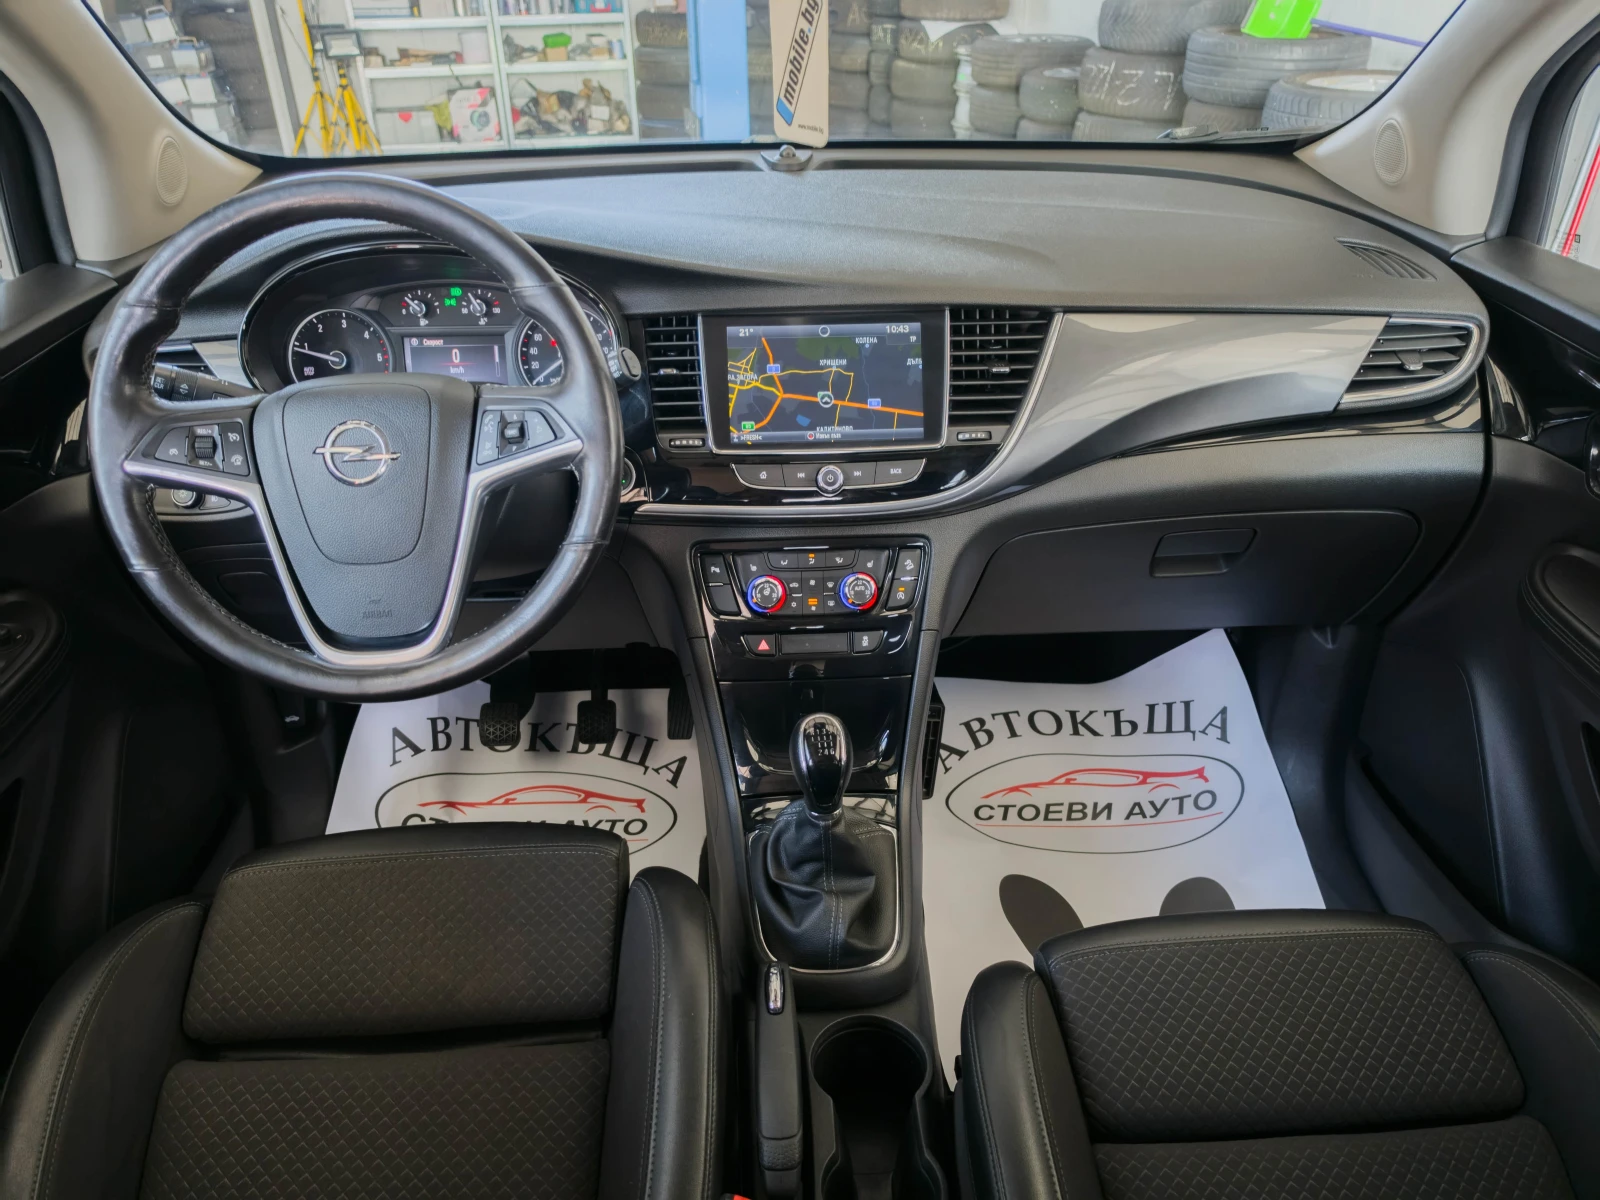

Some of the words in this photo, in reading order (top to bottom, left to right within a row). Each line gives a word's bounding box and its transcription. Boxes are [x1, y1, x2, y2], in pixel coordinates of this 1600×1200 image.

[341, 319, 347, 328] 3
[317, 324, 323, 333] 2
[885, 325, 910, 334] 10:43
[363, 330, 370, 339] 4
[534, 333, 543, 342] 60
[855, 336, 878, 344] КОЛЕНА
[452, 348, 460, 363] 0
[529, 347, 538, 355] 40
[531, 361, 540, 369] 20
[449, 366, 465, 374] km/h
[890, 467, 902, 475] BACK
[938, 700, 1230, 774] АВТОКЪЩА
[389, 716, 688, 788] АВТКЪЩА
[973, 802, 1113, 822] СТОЕВИ
[1124, 789, 1218, 821] АУТО
